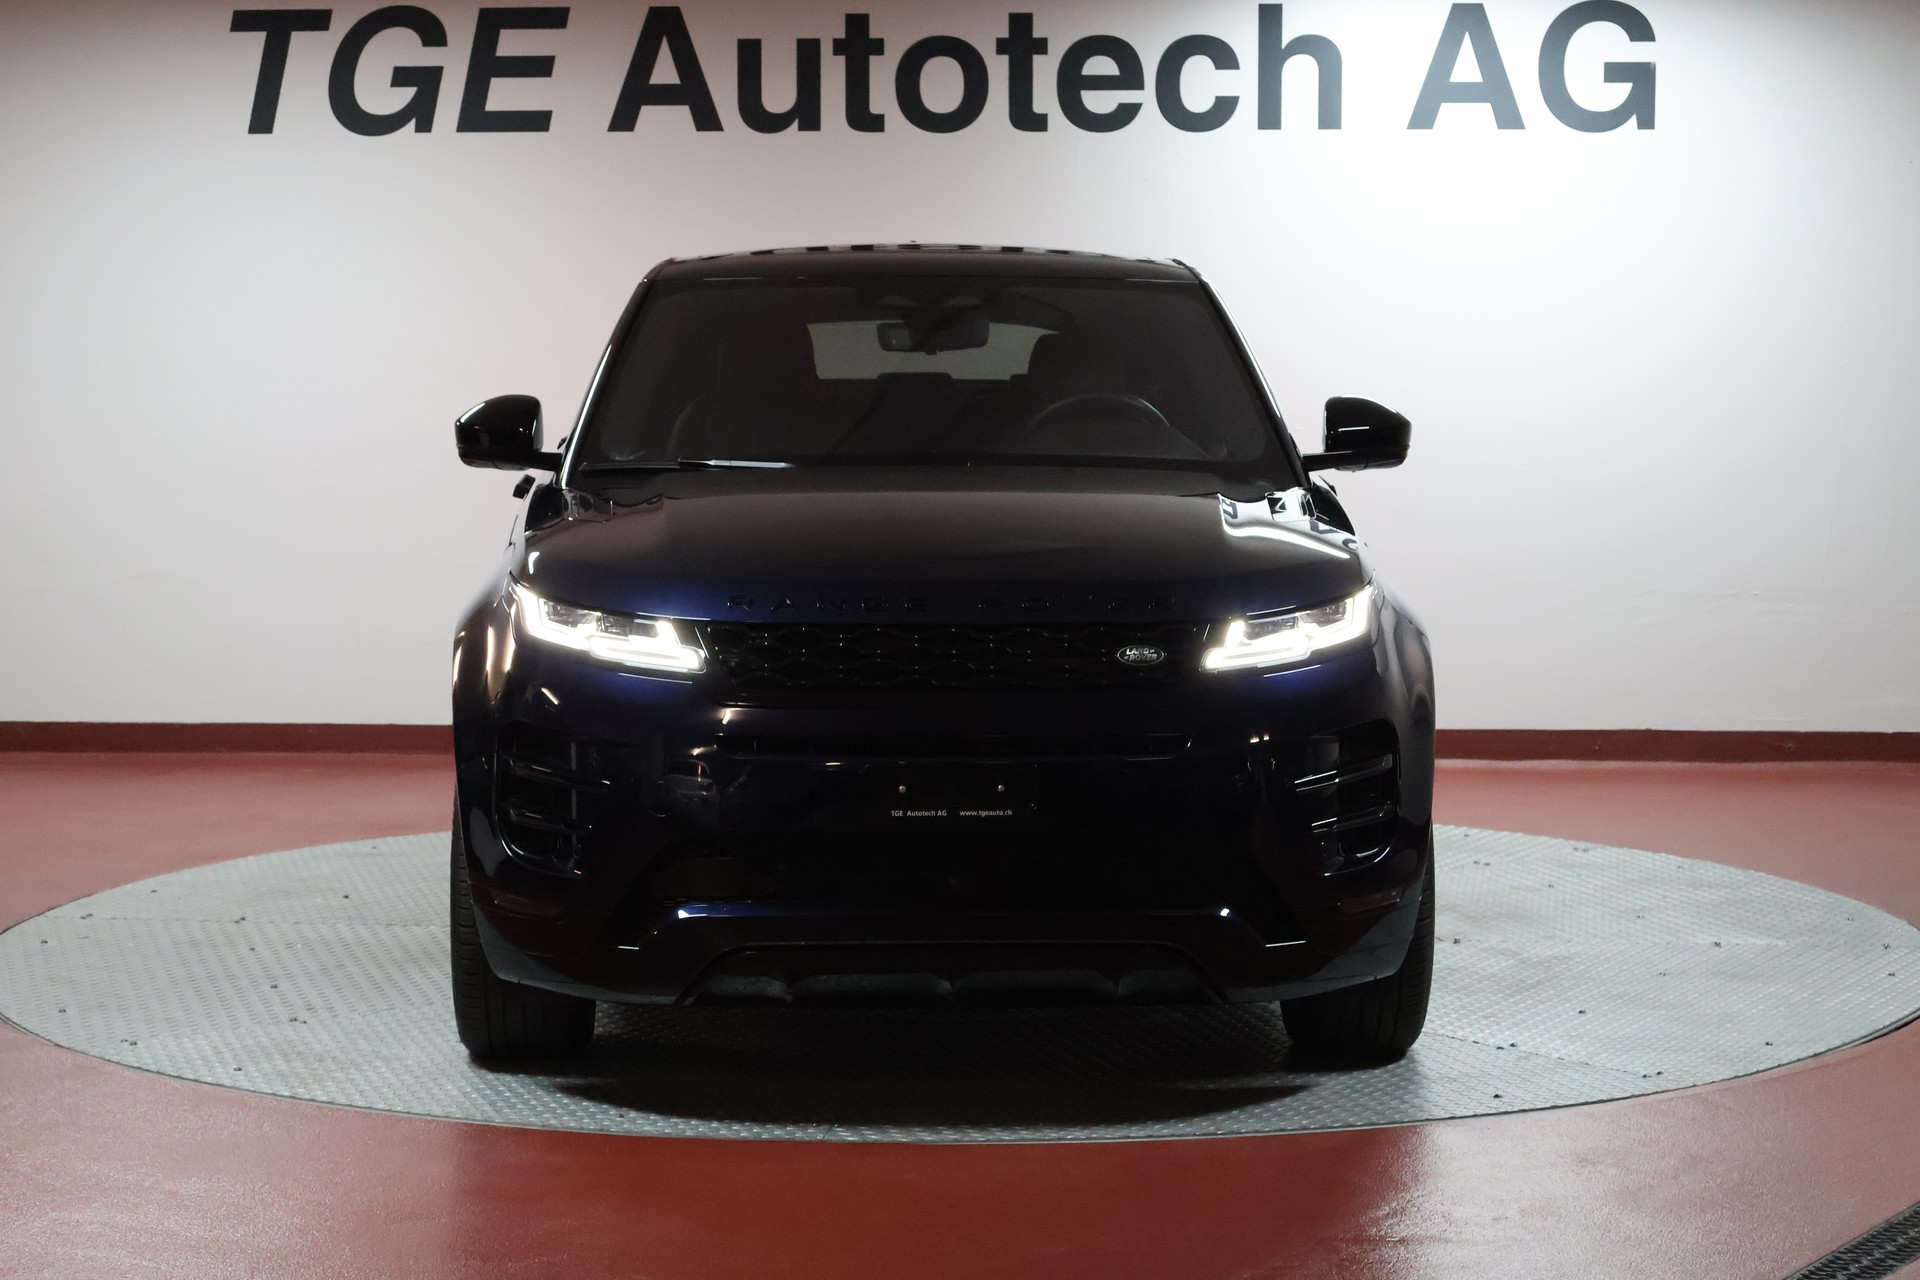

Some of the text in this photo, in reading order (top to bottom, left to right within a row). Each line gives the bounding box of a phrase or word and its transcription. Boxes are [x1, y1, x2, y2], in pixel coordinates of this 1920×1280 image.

[230, 0, 1656, 137] TGE Autotech AG
[959, 809, 1013, 818] www.tgeauto.ch
